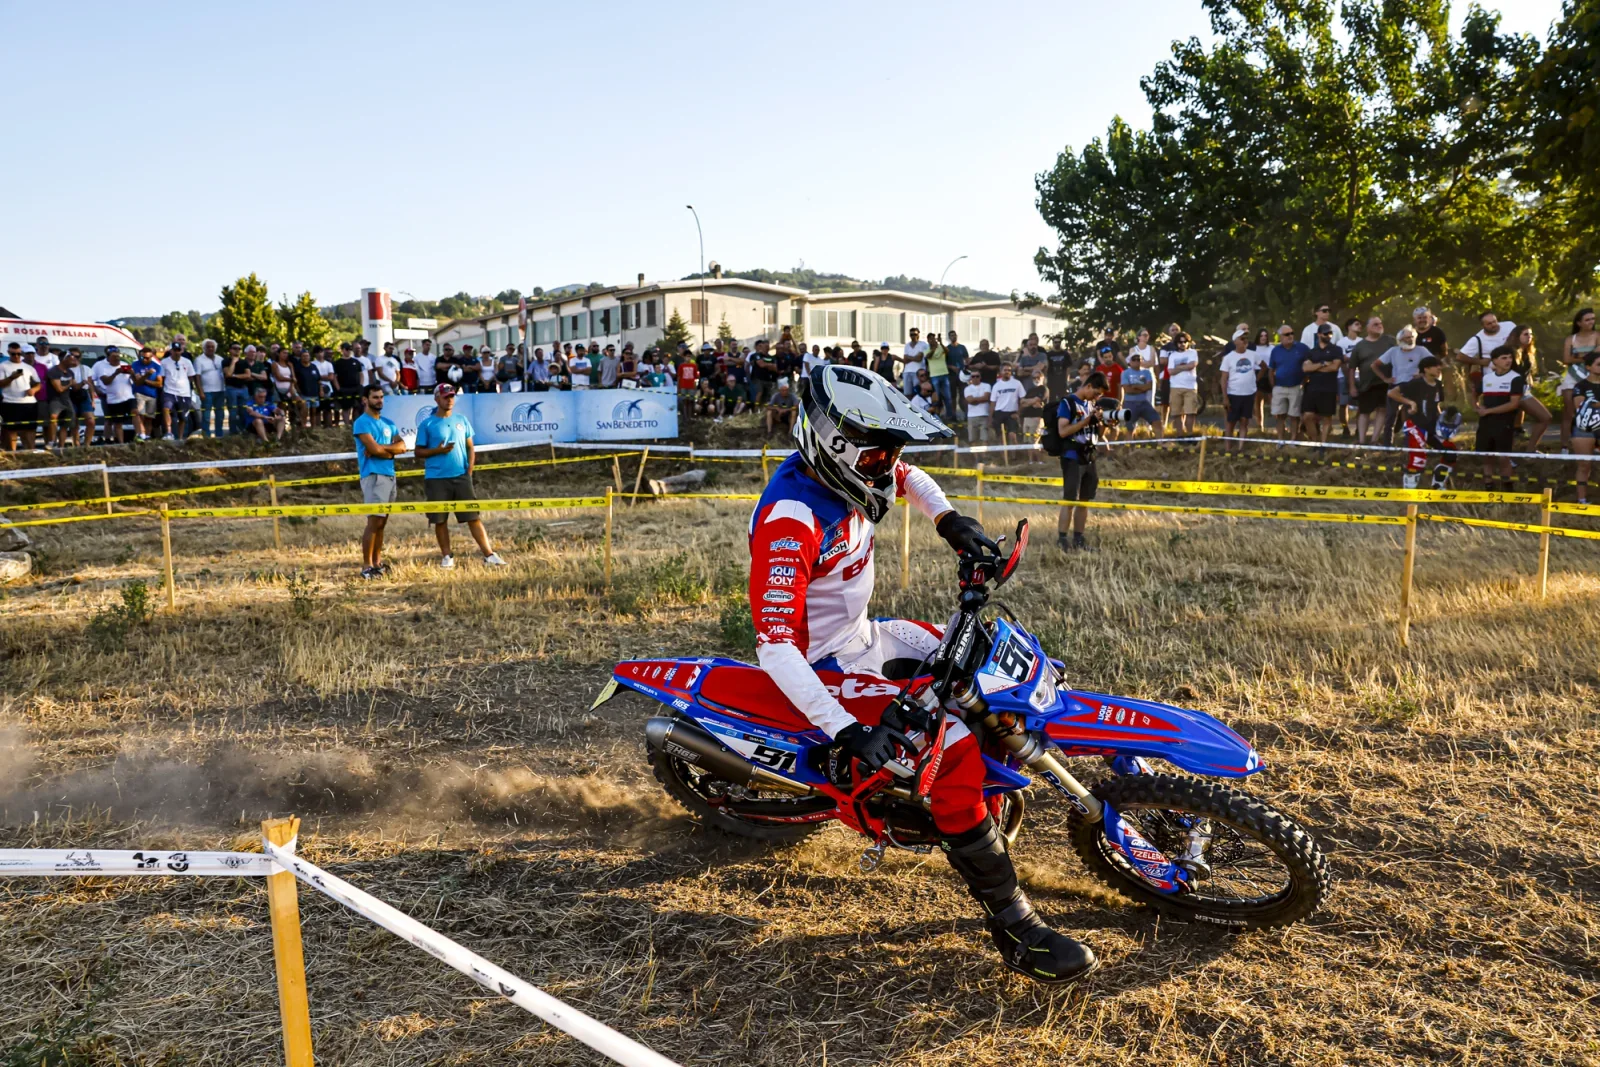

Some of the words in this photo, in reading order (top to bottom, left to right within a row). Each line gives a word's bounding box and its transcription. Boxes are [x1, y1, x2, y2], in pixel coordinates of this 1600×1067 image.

[13, 327, 48, 336] ROSSA
[53, 329, 98, 338] ITALIANA
[825, 678, 901, 699] eta
[671, 698, 690, 710] HGS
[672, 746, 699, 760] HGS
[750, 745, 798, 775] 91
[1040, 770, 1090, 815] Beta
[1194, 913, 1248, 927] METZELER
